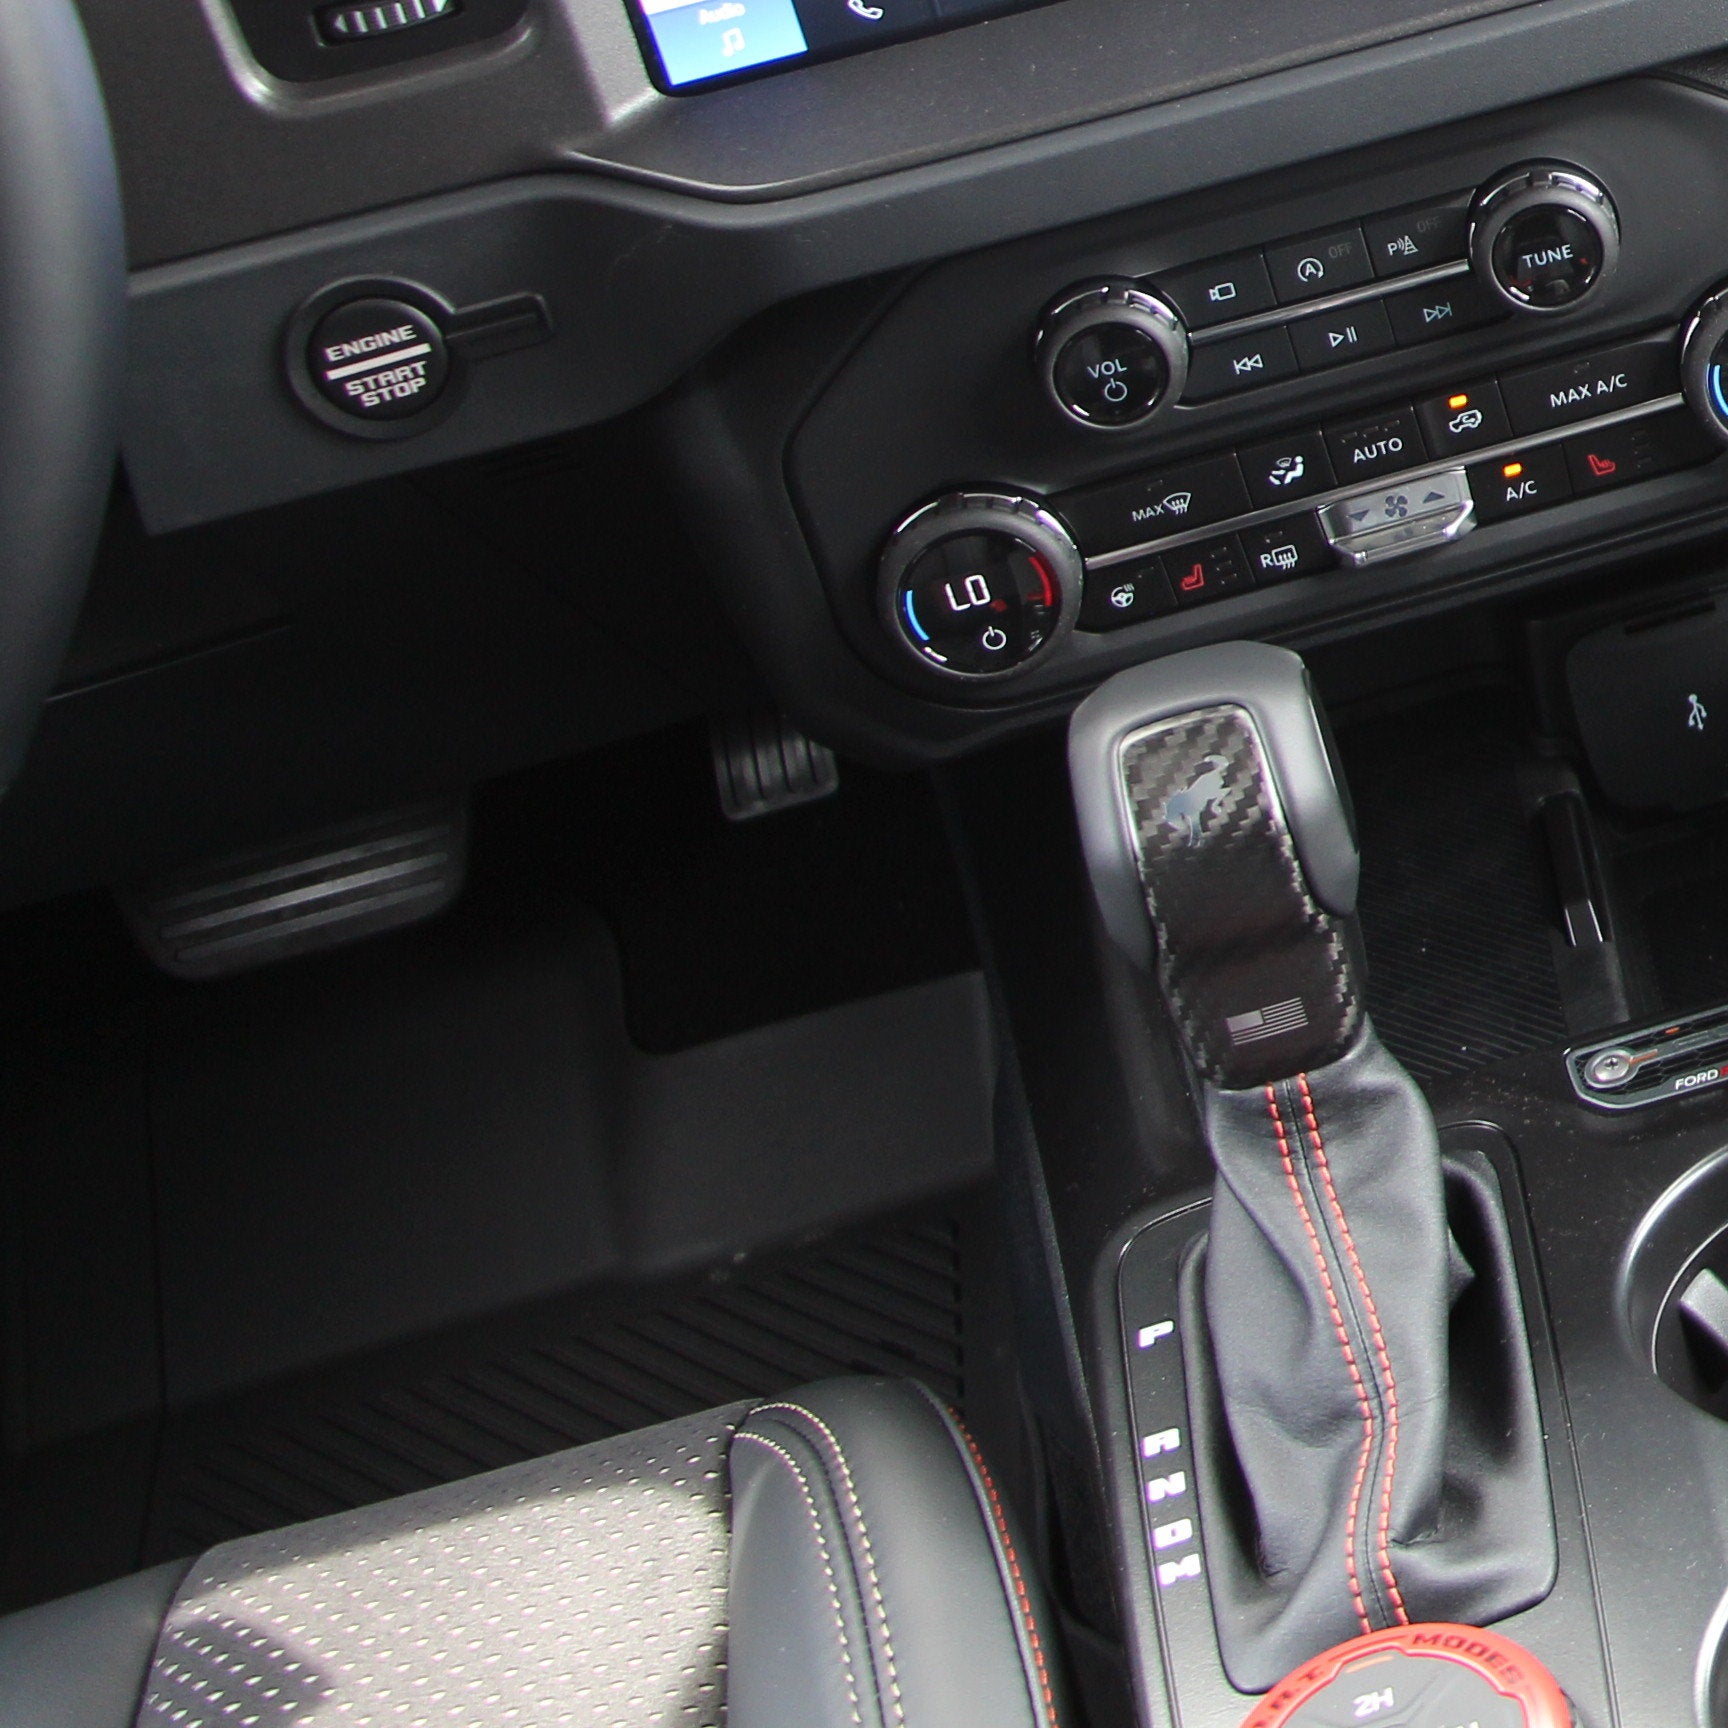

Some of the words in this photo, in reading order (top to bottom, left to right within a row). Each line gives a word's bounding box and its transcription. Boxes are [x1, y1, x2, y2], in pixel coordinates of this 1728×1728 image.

[698, 1, 746, 26] Audio
[1522, 244, 1574, 269] TUNE
[326, 324, 417, 362] ENGINE
[344, 360, 427, 396] START
[1087, 358, 1127, 379] VOL
[360, 377, 427, 407] STOP
[1550, 384, 1592, 408] MAX
[1596, 373, 1628, 396] A/C
[1353, 437, 1403, 463] AUTO
[1506, 480, 1538, 502] A/C
[1132, 503, 1165, 522] MAX
[944, 574, 991, 611] LO
[1675, 1069, 1718, 1090] FORD
[1138, 1320, 1174, 1348] P
[1141, 1427, 1181, 1459] R
[1147, 1471, 1187, 1503] N
[1153, 1518, 1193, 1549] D
[1158, 1553, 1201, 1586] M
[1411, 1632, 1526, 1686] MODES
[1352, 1686, 1395, 1720] 2H
